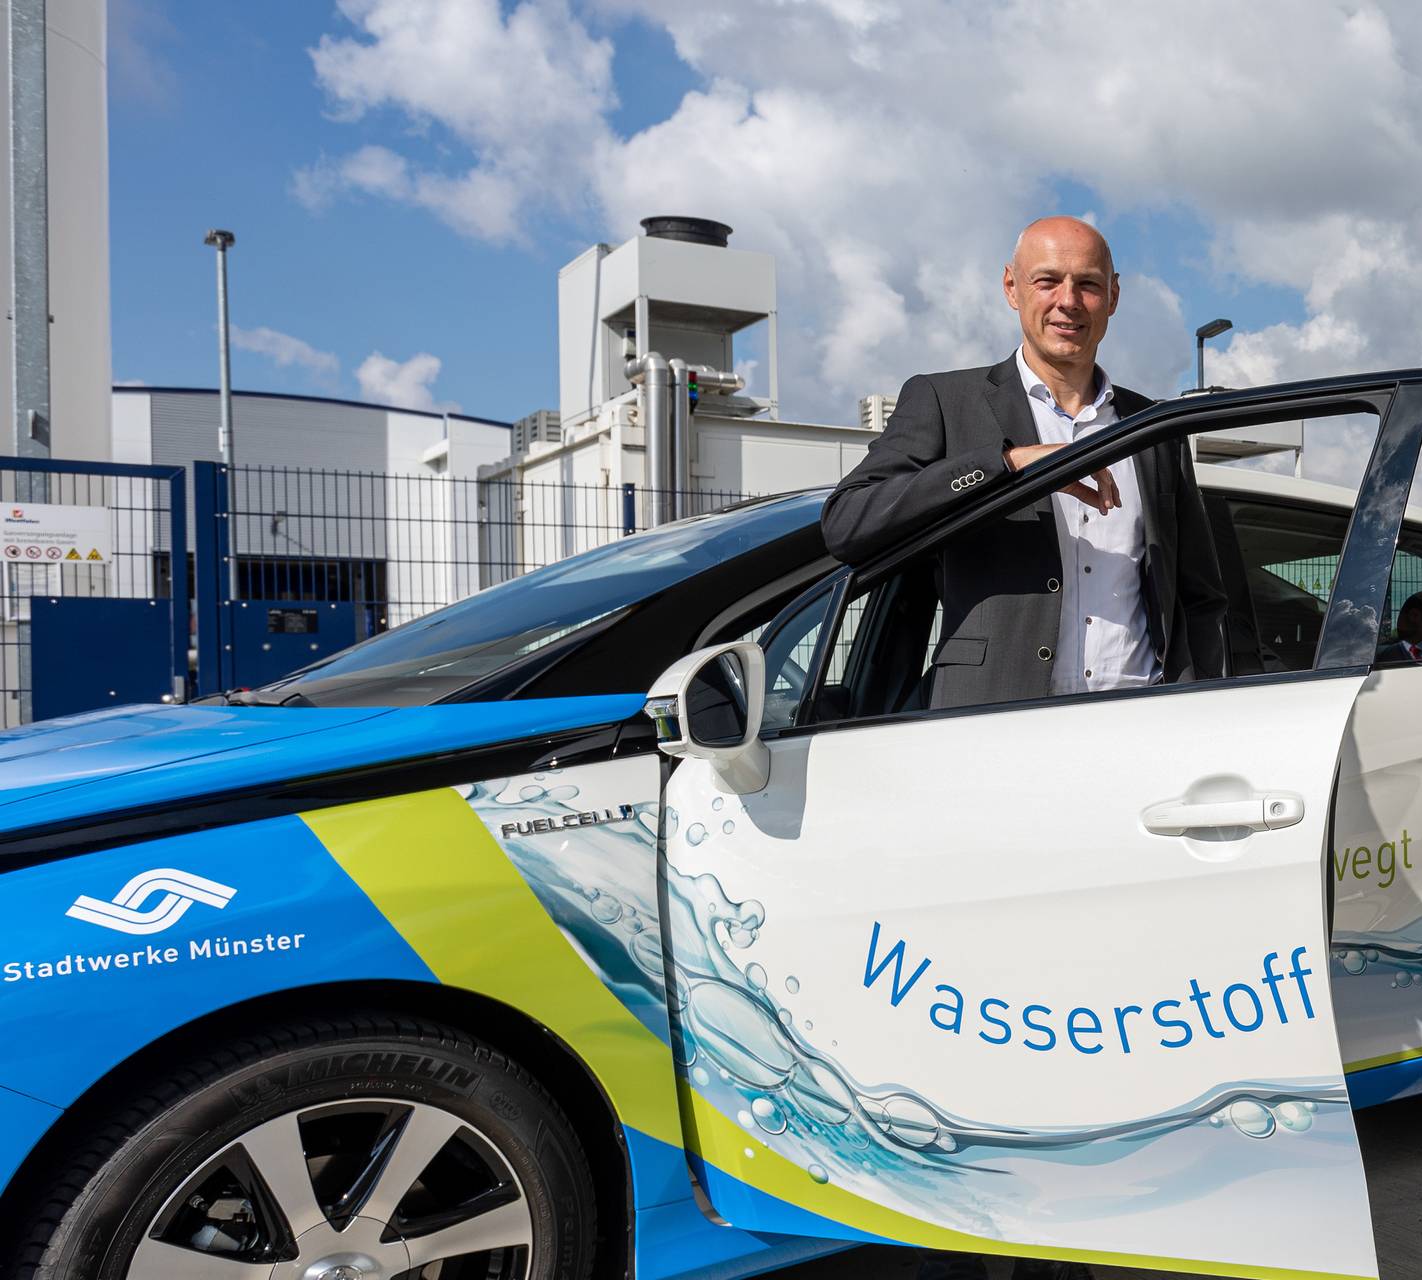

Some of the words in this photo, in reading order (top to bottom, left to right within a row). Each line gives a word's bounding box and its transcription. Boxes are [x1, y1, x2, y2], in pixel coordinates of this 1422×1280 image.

[3, 945, 180, 983] Stadtwerke
[189, 933, 306, 961] Münster
[863, 920, 1316, 1055] Wasserstoff
